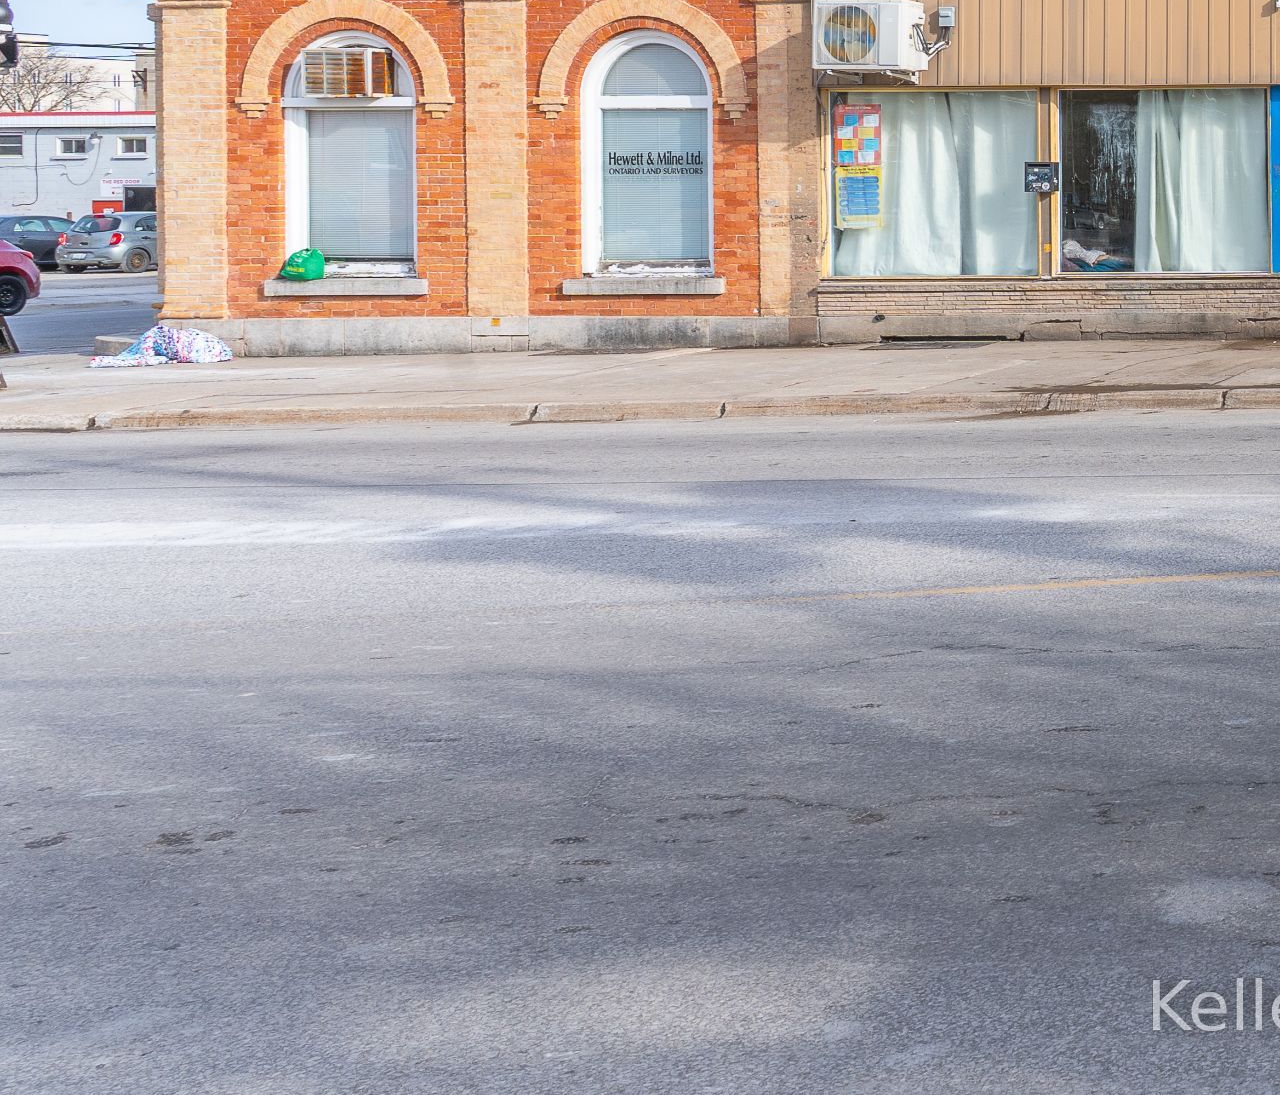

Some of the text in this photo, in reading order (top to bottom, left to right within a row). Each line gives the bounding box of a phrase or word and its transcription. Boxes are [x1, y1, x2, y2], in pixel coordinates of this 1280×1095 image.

[609, 151, 703, 165] Hewett & Milne Ltd.
[609, 167, 703, 175] ONTARIO LAND SURVEYORS
